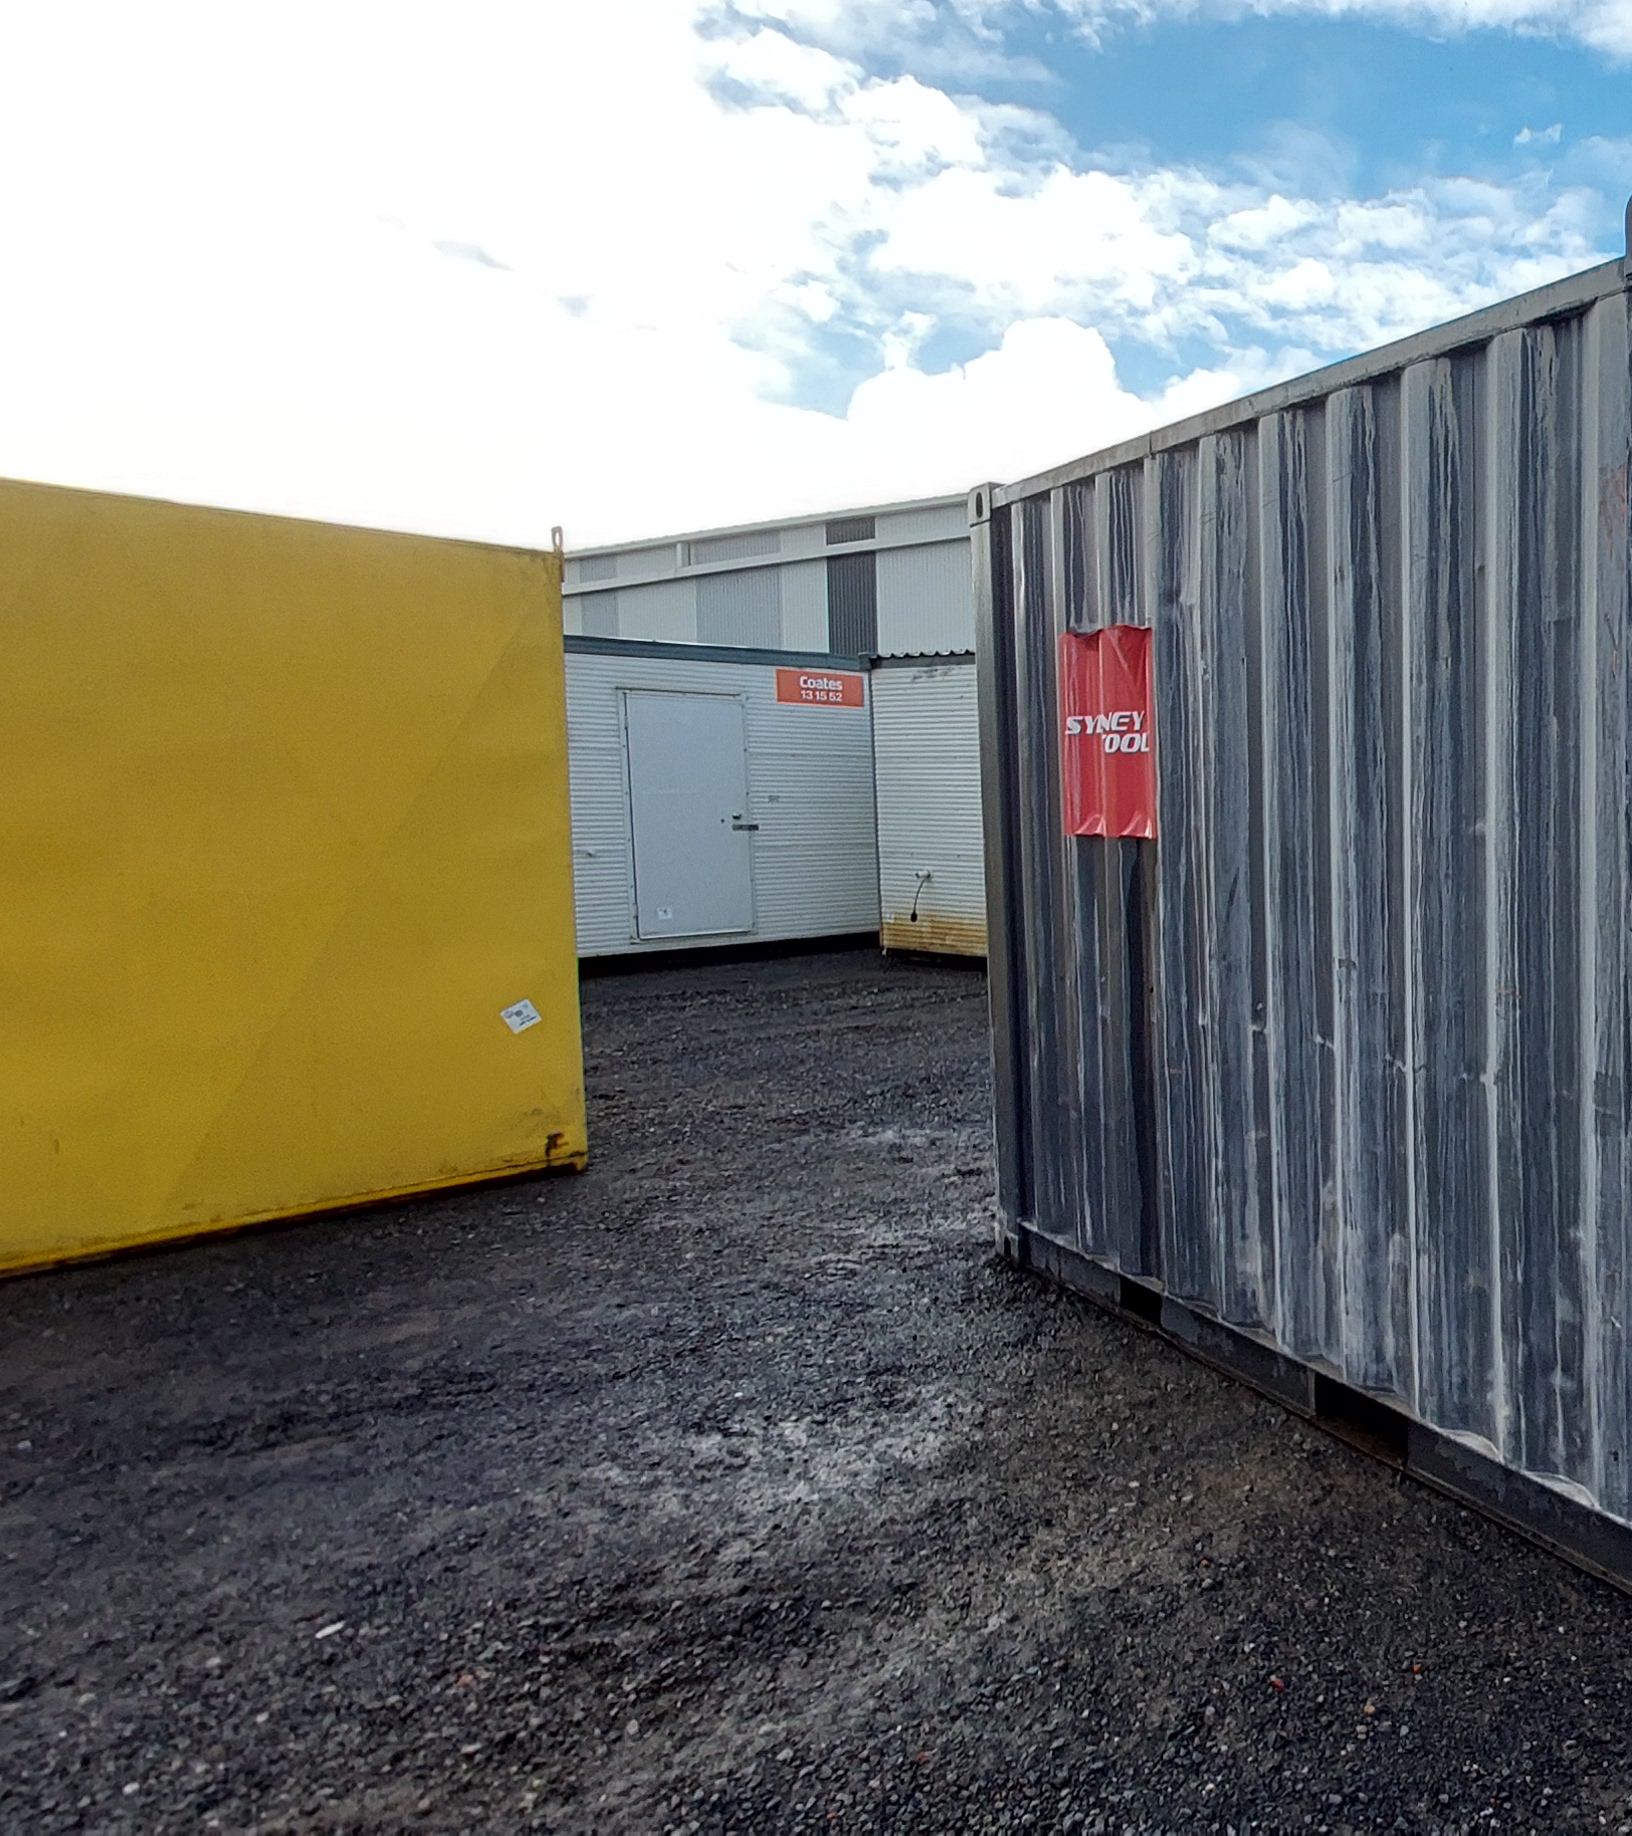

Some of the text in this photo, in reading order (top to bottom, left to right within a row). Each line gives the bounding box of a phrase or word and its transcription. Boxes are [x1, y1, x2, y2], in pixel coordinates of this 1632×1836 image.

[799, 676, 843, 691] Coates
[800, 690, 813, 700] 13
[815, 691, 827, 701] 15
[1102, 731, 1150, 753] OOL
